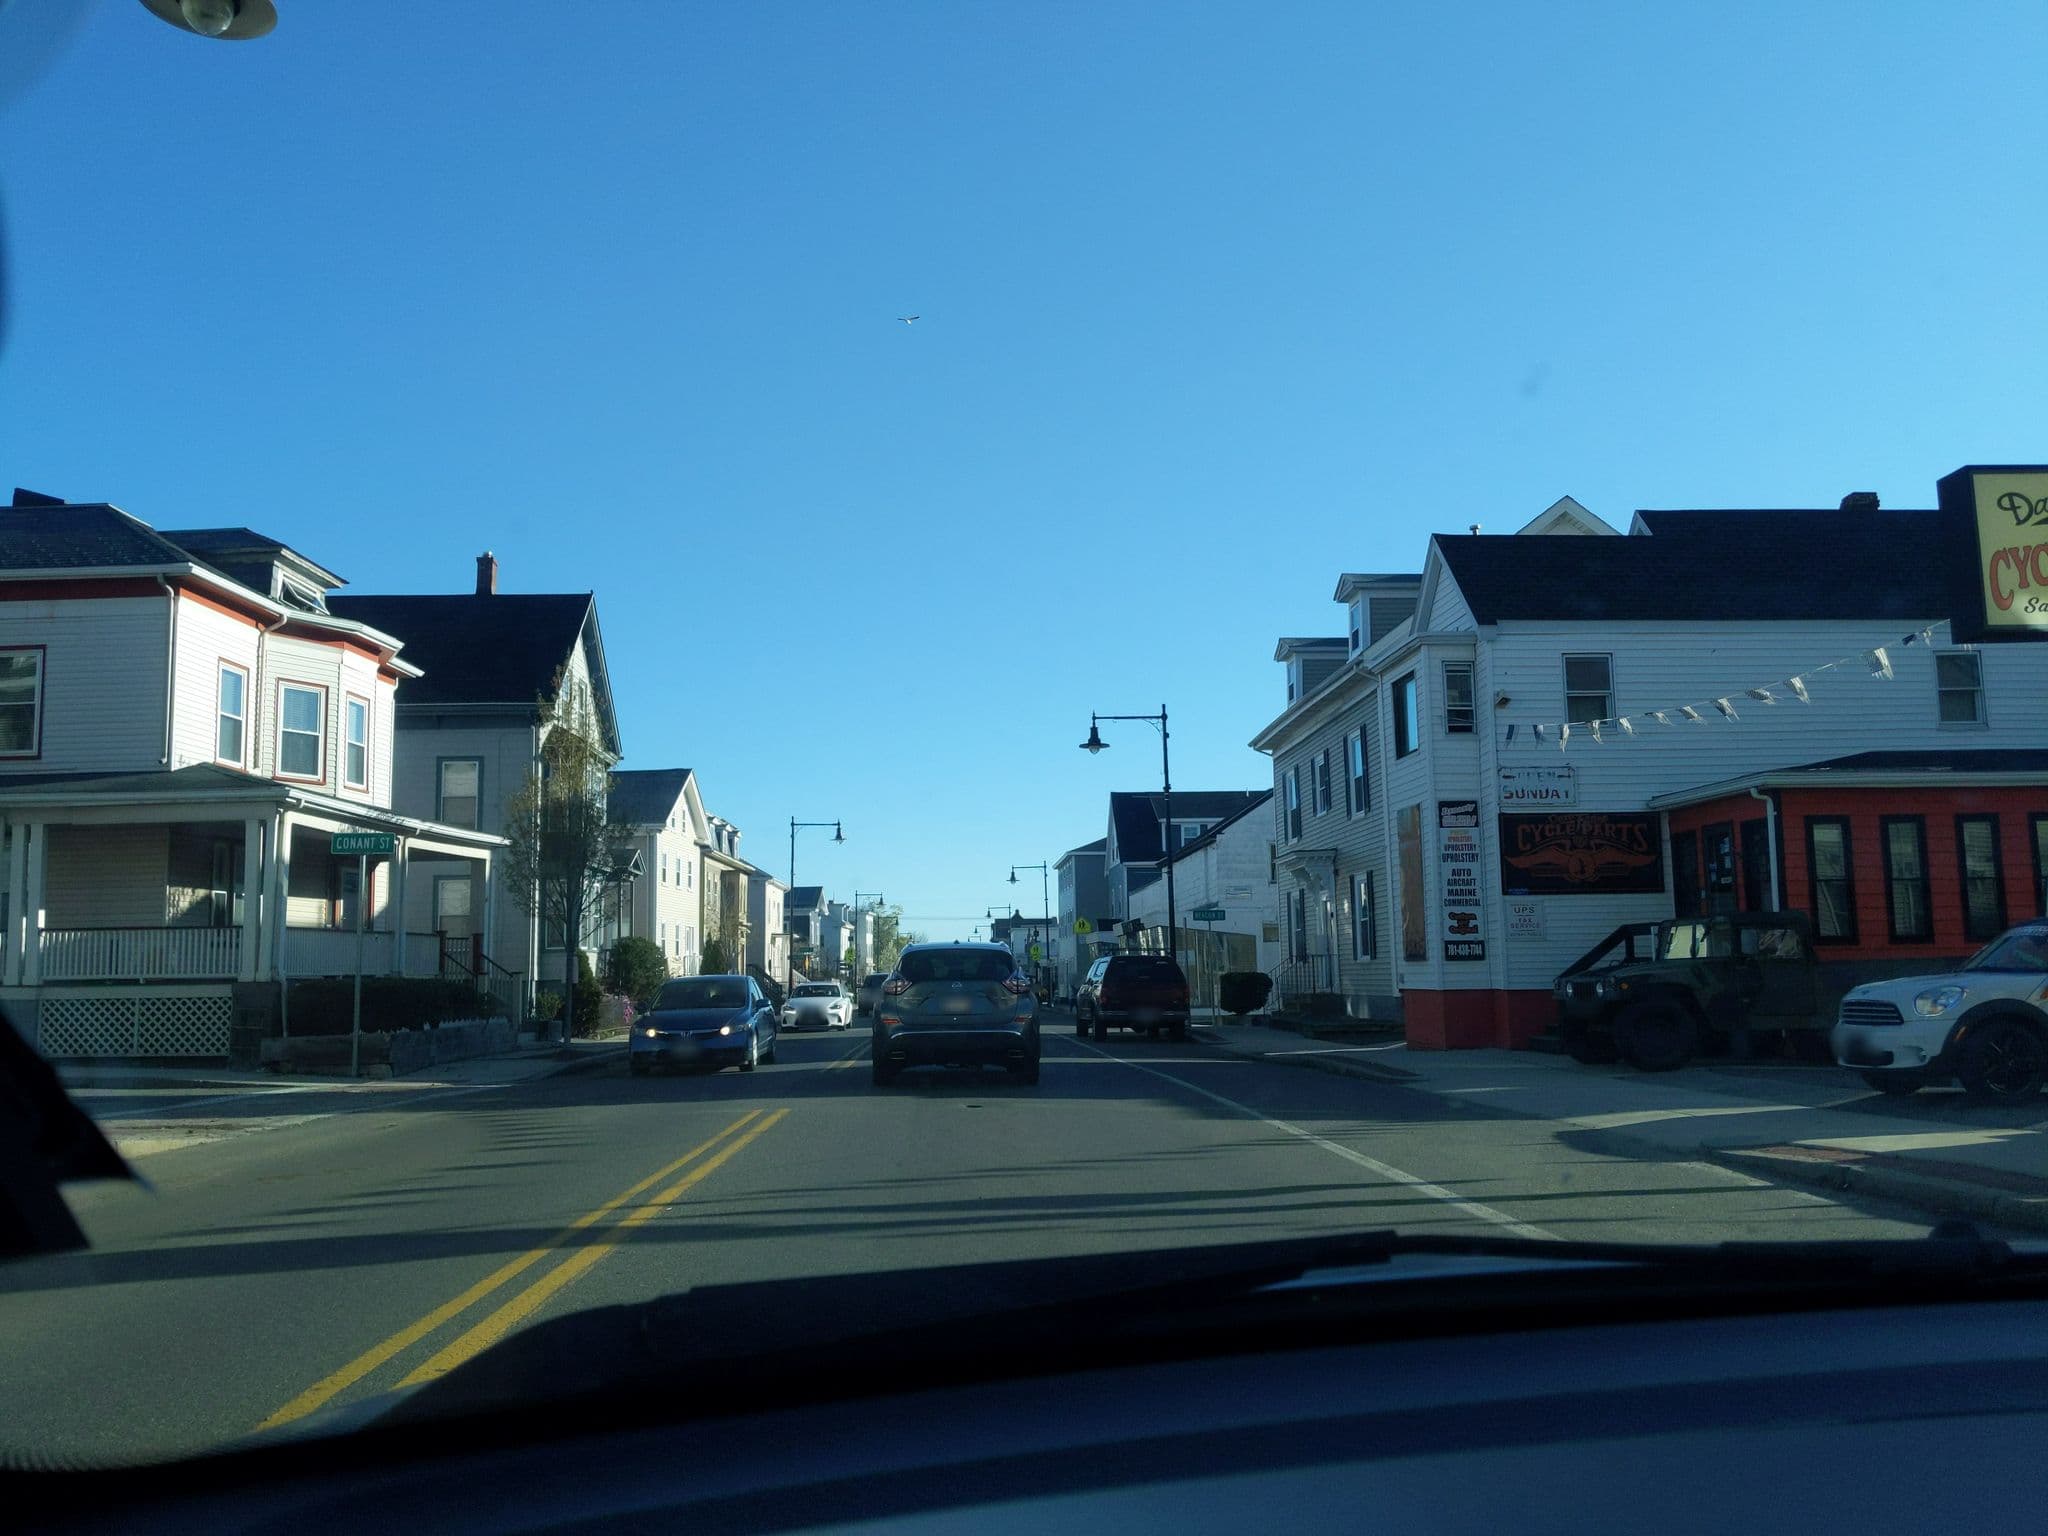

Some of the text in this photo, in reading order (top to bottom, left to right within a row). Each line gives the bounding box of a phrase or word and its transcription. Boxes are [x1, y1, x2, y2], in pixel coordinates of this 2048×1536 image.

[1989, 543, 2048, 611] CYC
[1517, 822, 1648, 852] CYCLE PARTS
[336, 837, 391, 849] CONANT ST
[1444, 843, 1477, 852] UPHOLSTERY
[1442, 852, 1479, 863] UPHOLSTERY
[1451, 868, 1472, 877] AUTO
[1447, 878, 1476, 887] AIRCRAFT
[1447, 888, 1477, 897] MARINE
[1443, 898, 1481, 907] COMMERCIAL
[1513, 906, 1535, 914] UPS
